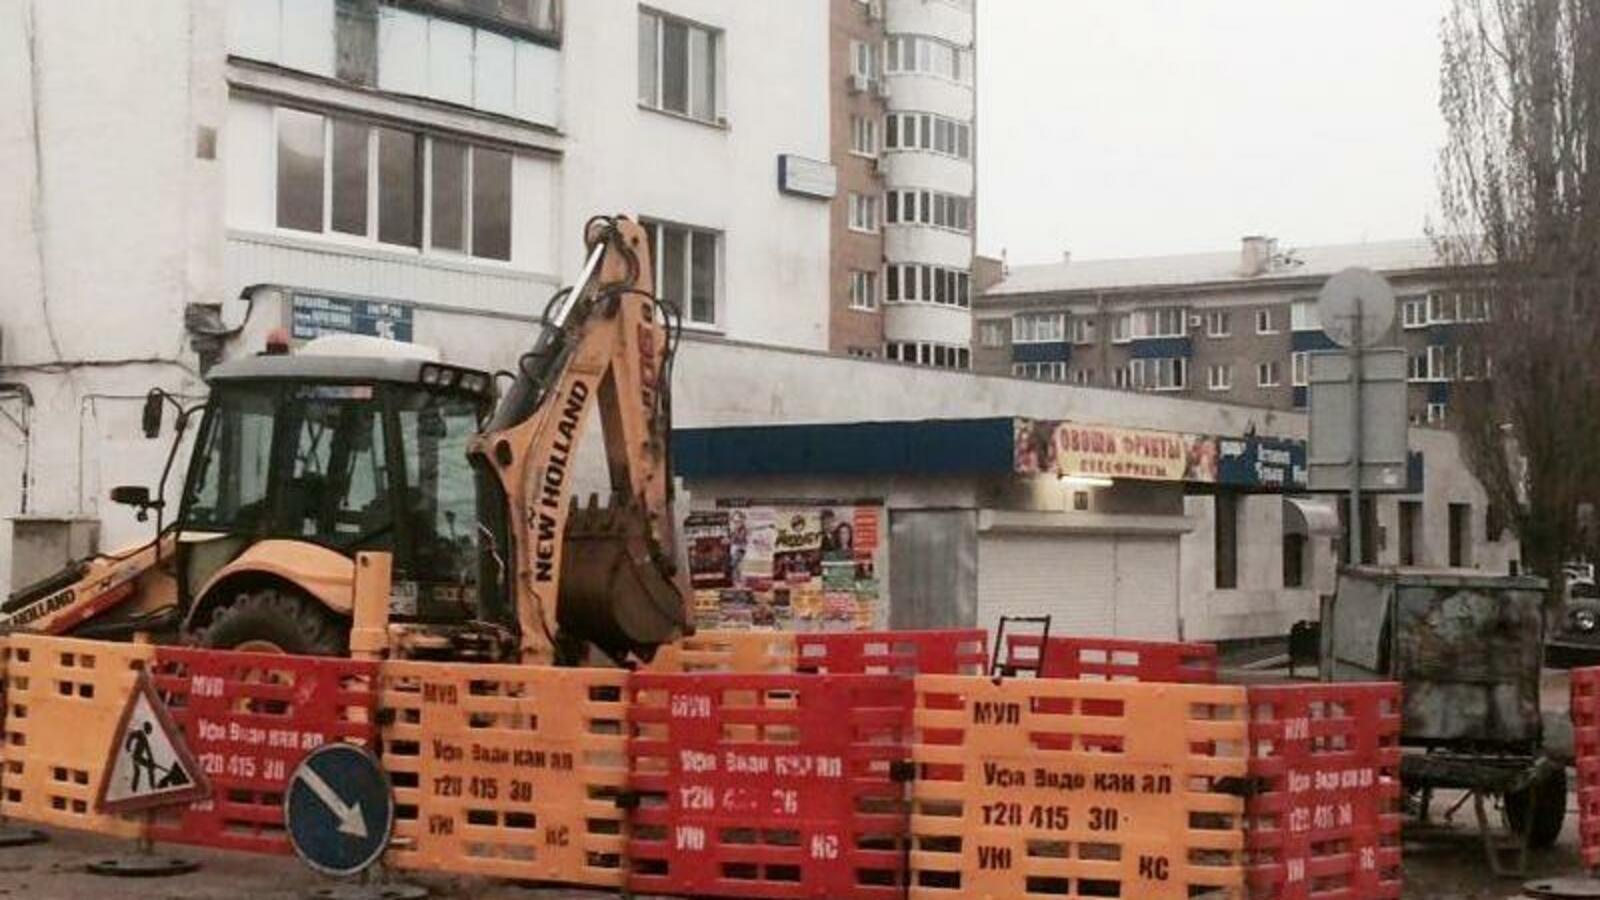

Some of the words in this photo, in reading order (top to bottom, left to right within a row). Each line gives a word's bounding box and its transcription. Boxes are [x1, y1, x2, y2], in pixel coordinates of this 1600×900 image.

[542, 380, 590, 508] HOLLAND
[535, 514, 556, 582] NEW
[973, 700, 1020, 725] МУП
[984, 762, 1026, 788] Уфа
[1029, 805, 1070, 831] 415
[1088, 806, 1118, 831] 30
[1138, 855, 1170, 881] КС
